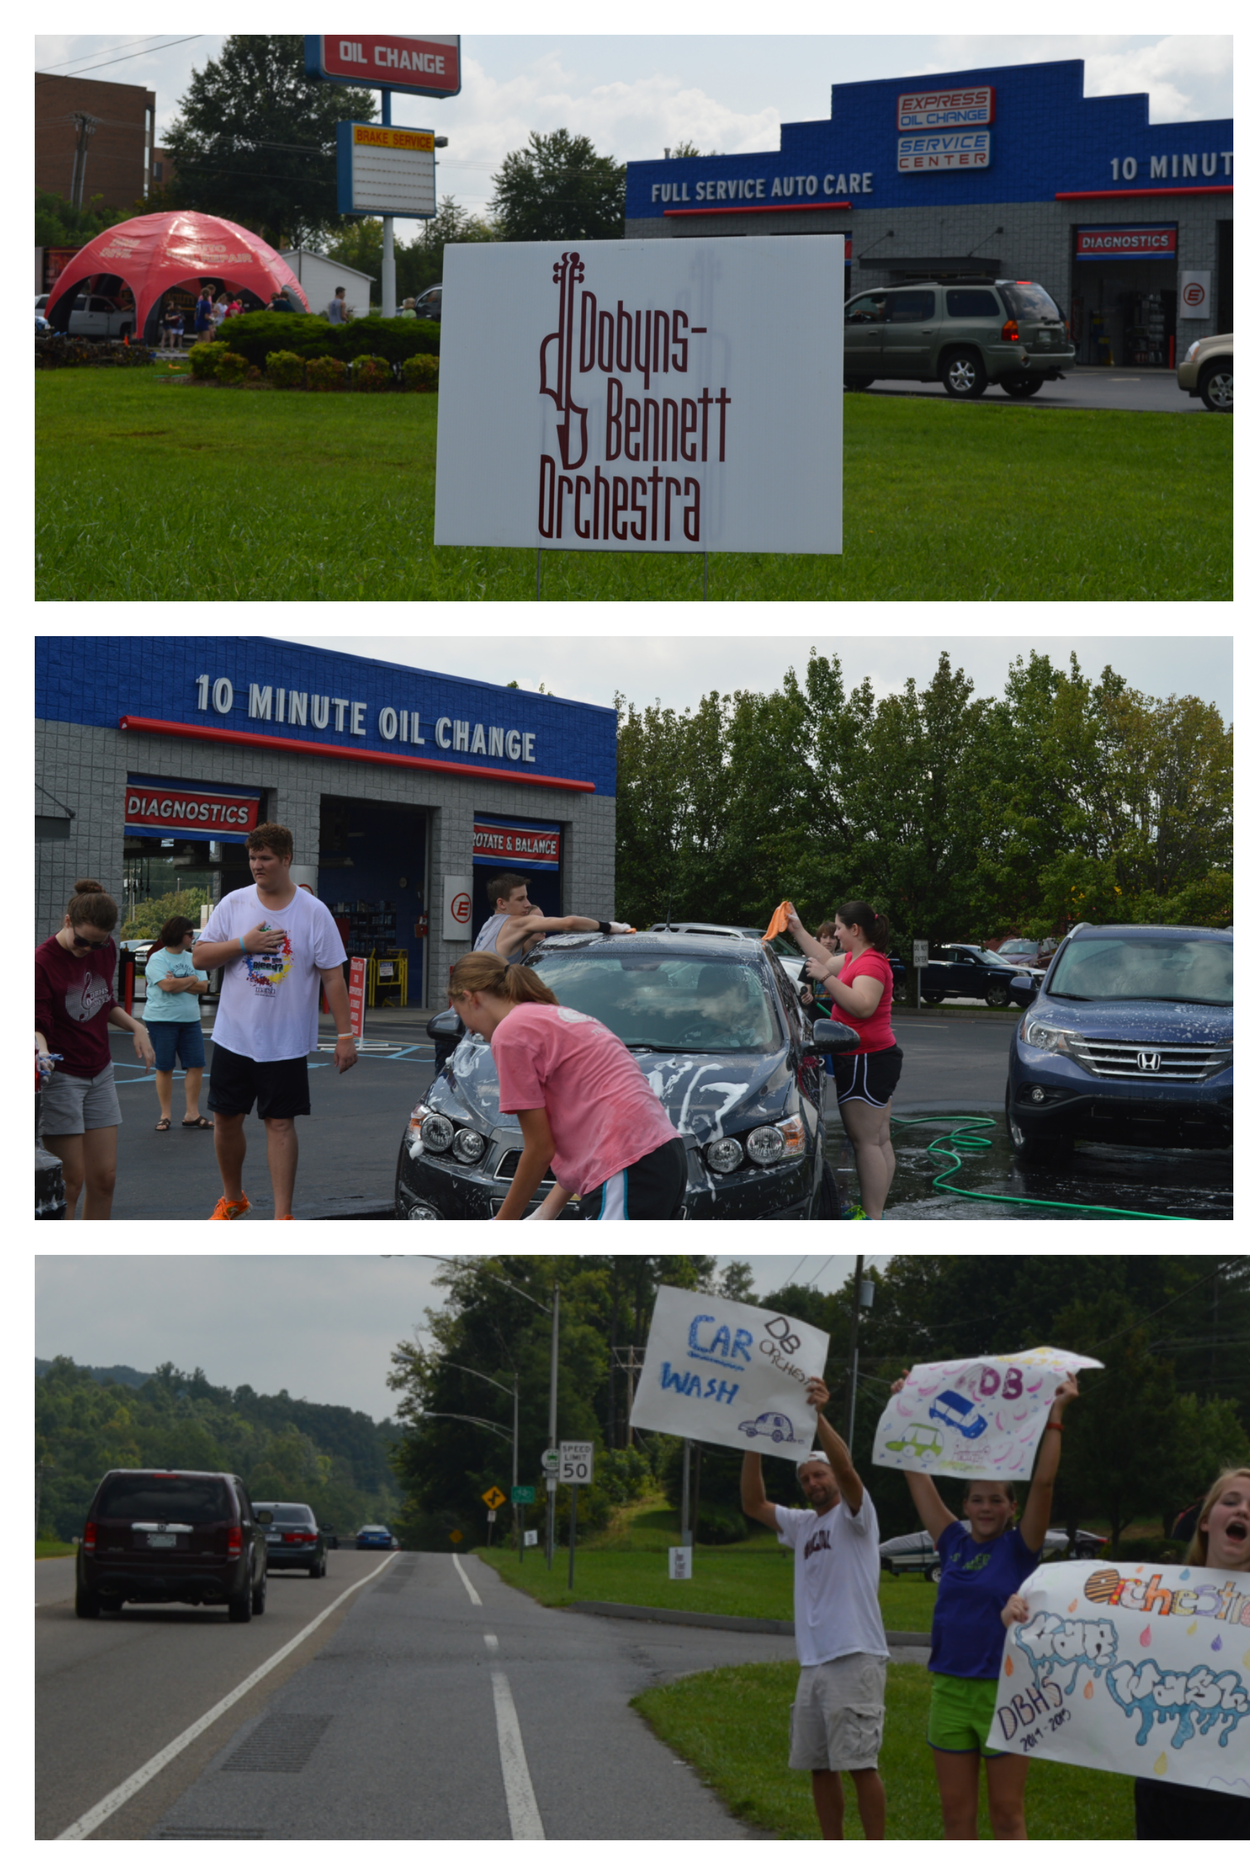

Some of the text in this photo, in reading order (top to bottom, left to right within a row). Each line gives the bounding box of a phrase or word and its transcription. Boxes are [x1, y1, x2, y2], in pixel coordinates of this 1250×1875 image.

[339, 40, 445, 75] OIL CHANGE
[901, 91, 988, 111] EXPRESS
[900, 109, 988, 126] OIL CHANGE
[356, 129, 432, 149] BRAKE SERVICE
[899, 135, 988, 153] SERVICE
[899, 152, 987, 169] CENTER
[1110, 156, 1138, 181] 10
[651, 172, 873, 203] FULL SERVICE AUTO CARE
[1082, 235, 1169, 249] DIAGNOSTICS
[579, 290, 707, 391] Dobyns-
[605, 377, 732, 463] Bennett
[538, 454, 701, 542] Orchestra
[195, 673, 536, 763] 10 MINUTE OIL CHANGE
[127, 796, 249, 825] DIAGNOSTICS
[506, 836, 513, 852] &
[515, 836, 557, 855] BALANCE
[687, 1314, 754, 1362] CAR
[764, 1316, 801, 1355] DB
[661, 1361, 740, 1405] WASH
[979, 1367, 1023, 1400] DB
[562, 1445, 591, 1453] SPEED
[564, 1453, 587, 1461] LIMIT
[563, 1463, 588, 1478] 50
[997, 1675, 1063, 1740] DBHS
